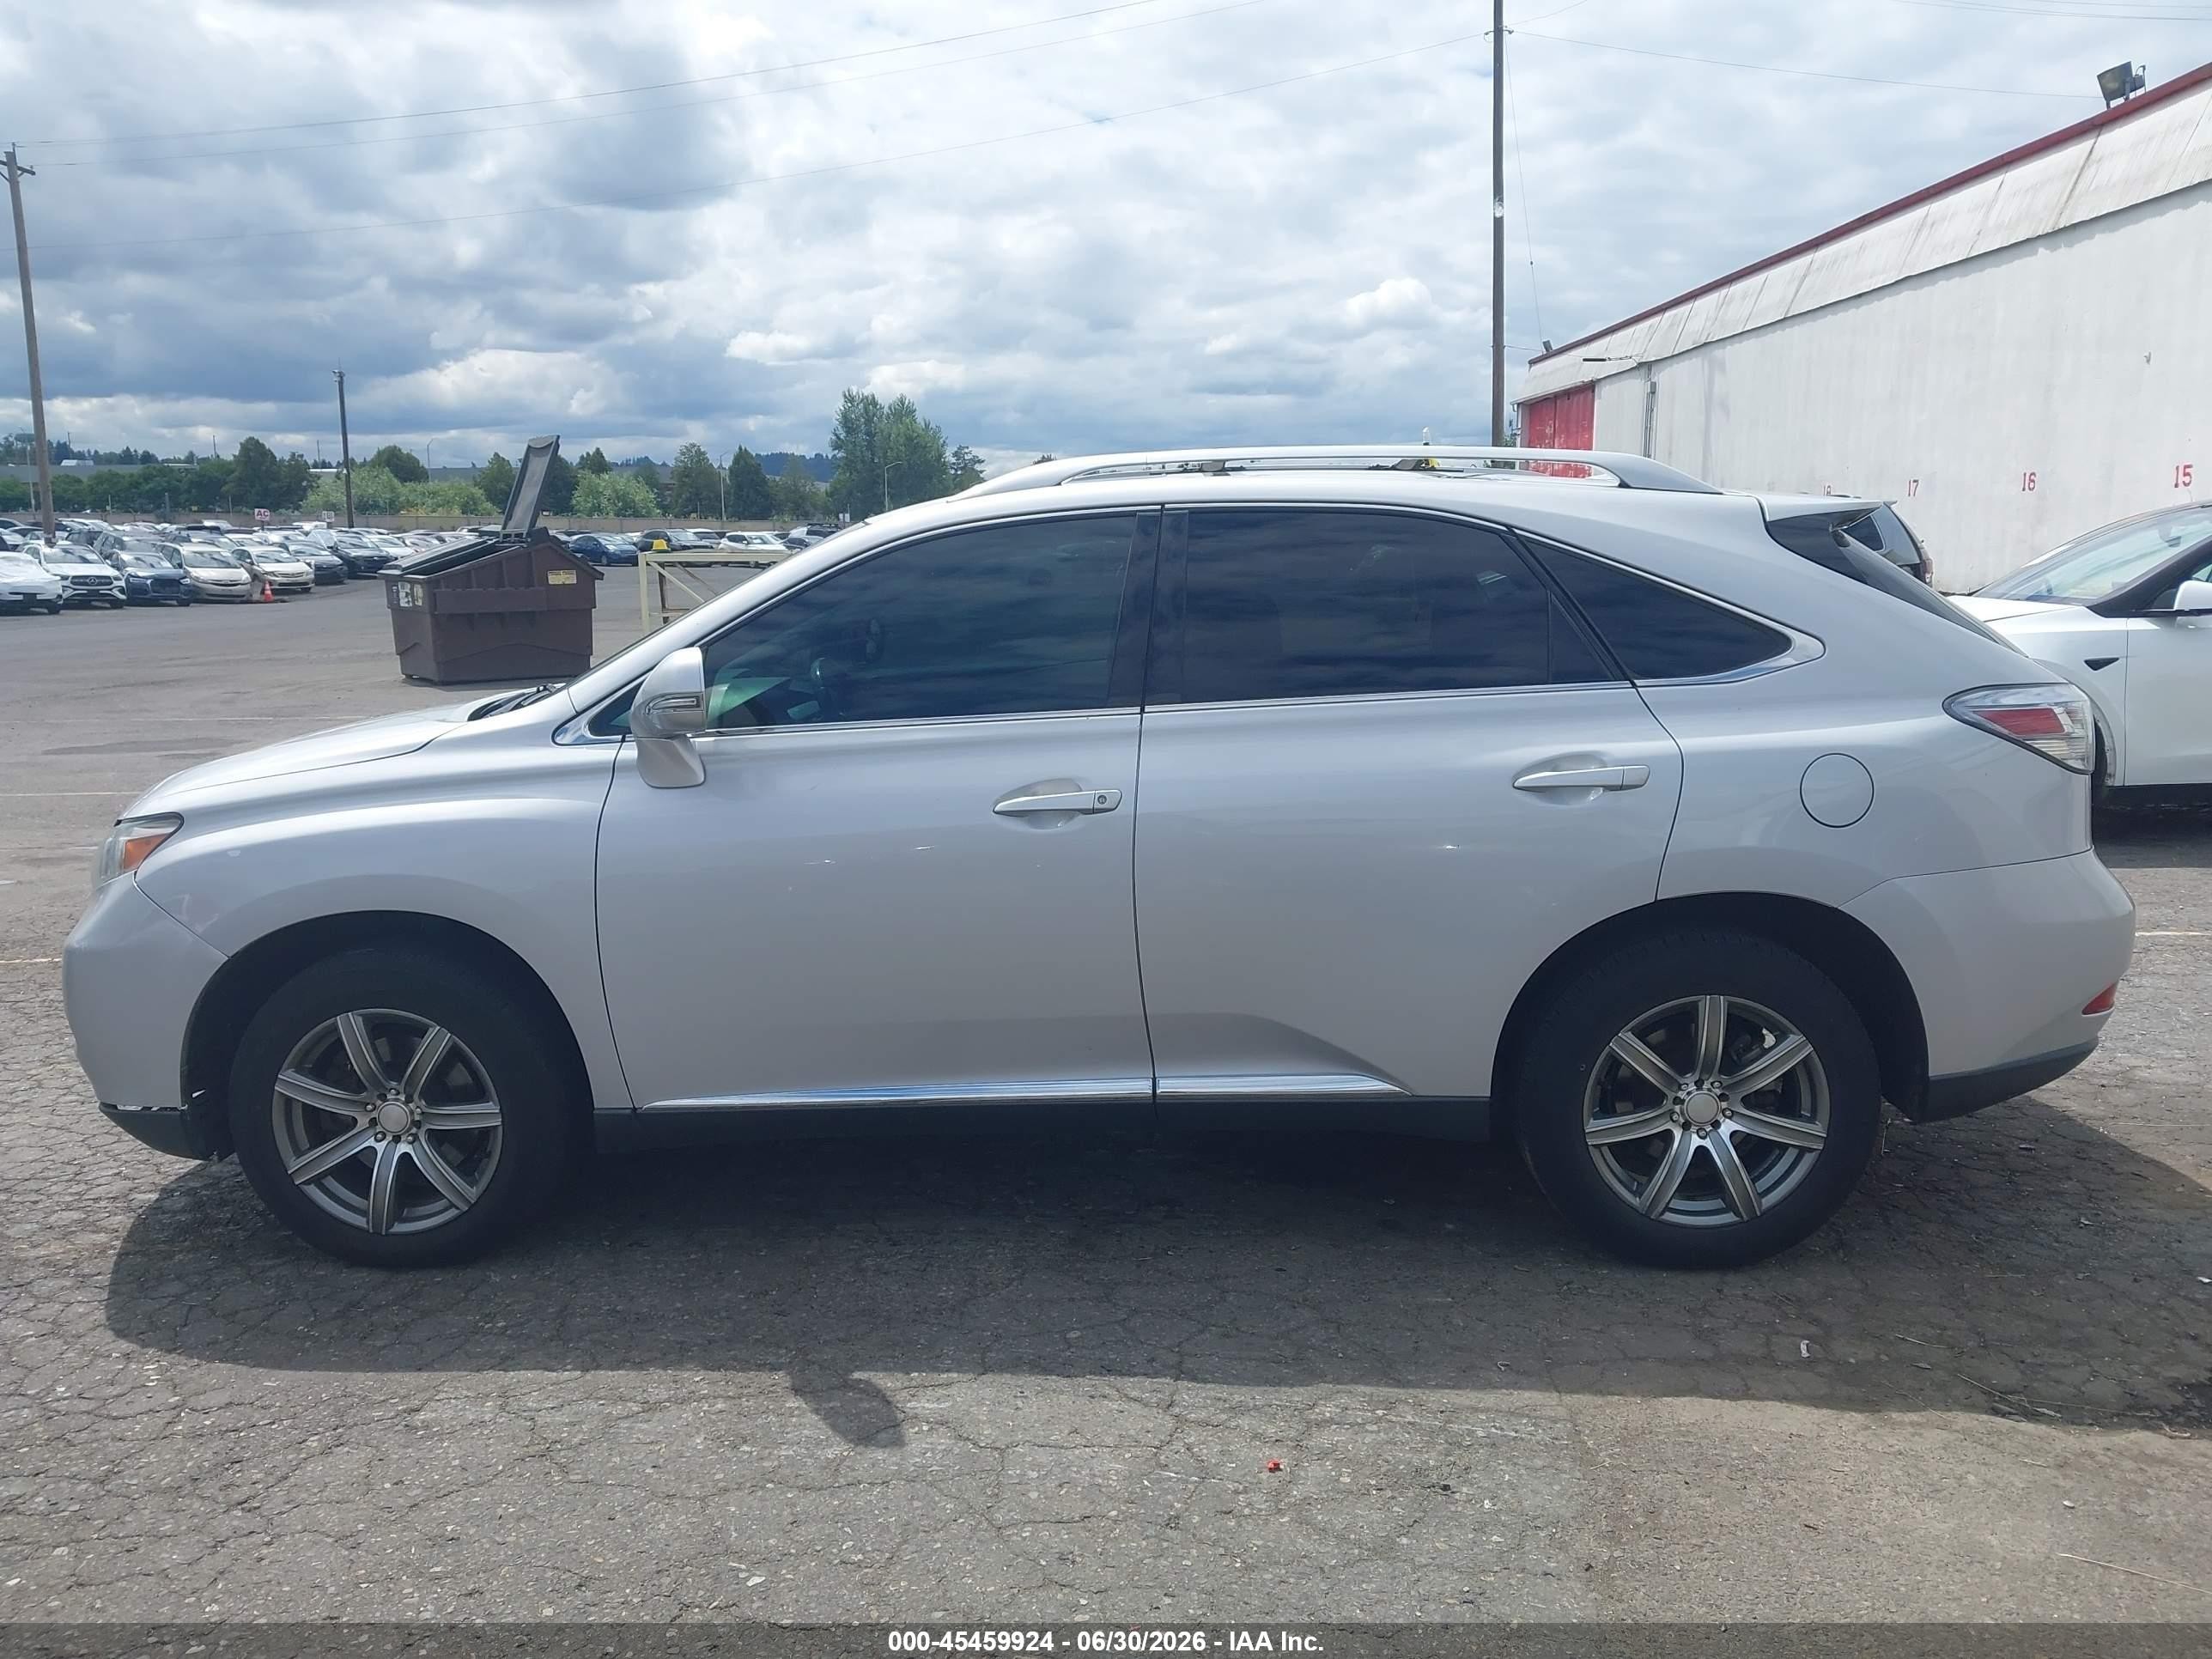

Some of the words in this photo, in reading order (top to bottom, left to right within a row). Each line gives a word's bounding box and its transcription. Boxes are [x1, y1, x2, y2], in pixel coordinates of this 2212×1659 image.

[2021, 471, 2037, 492] 16
[2173, 464, 2194, 489] 15
[1907, 479, 1920, 497] 17
